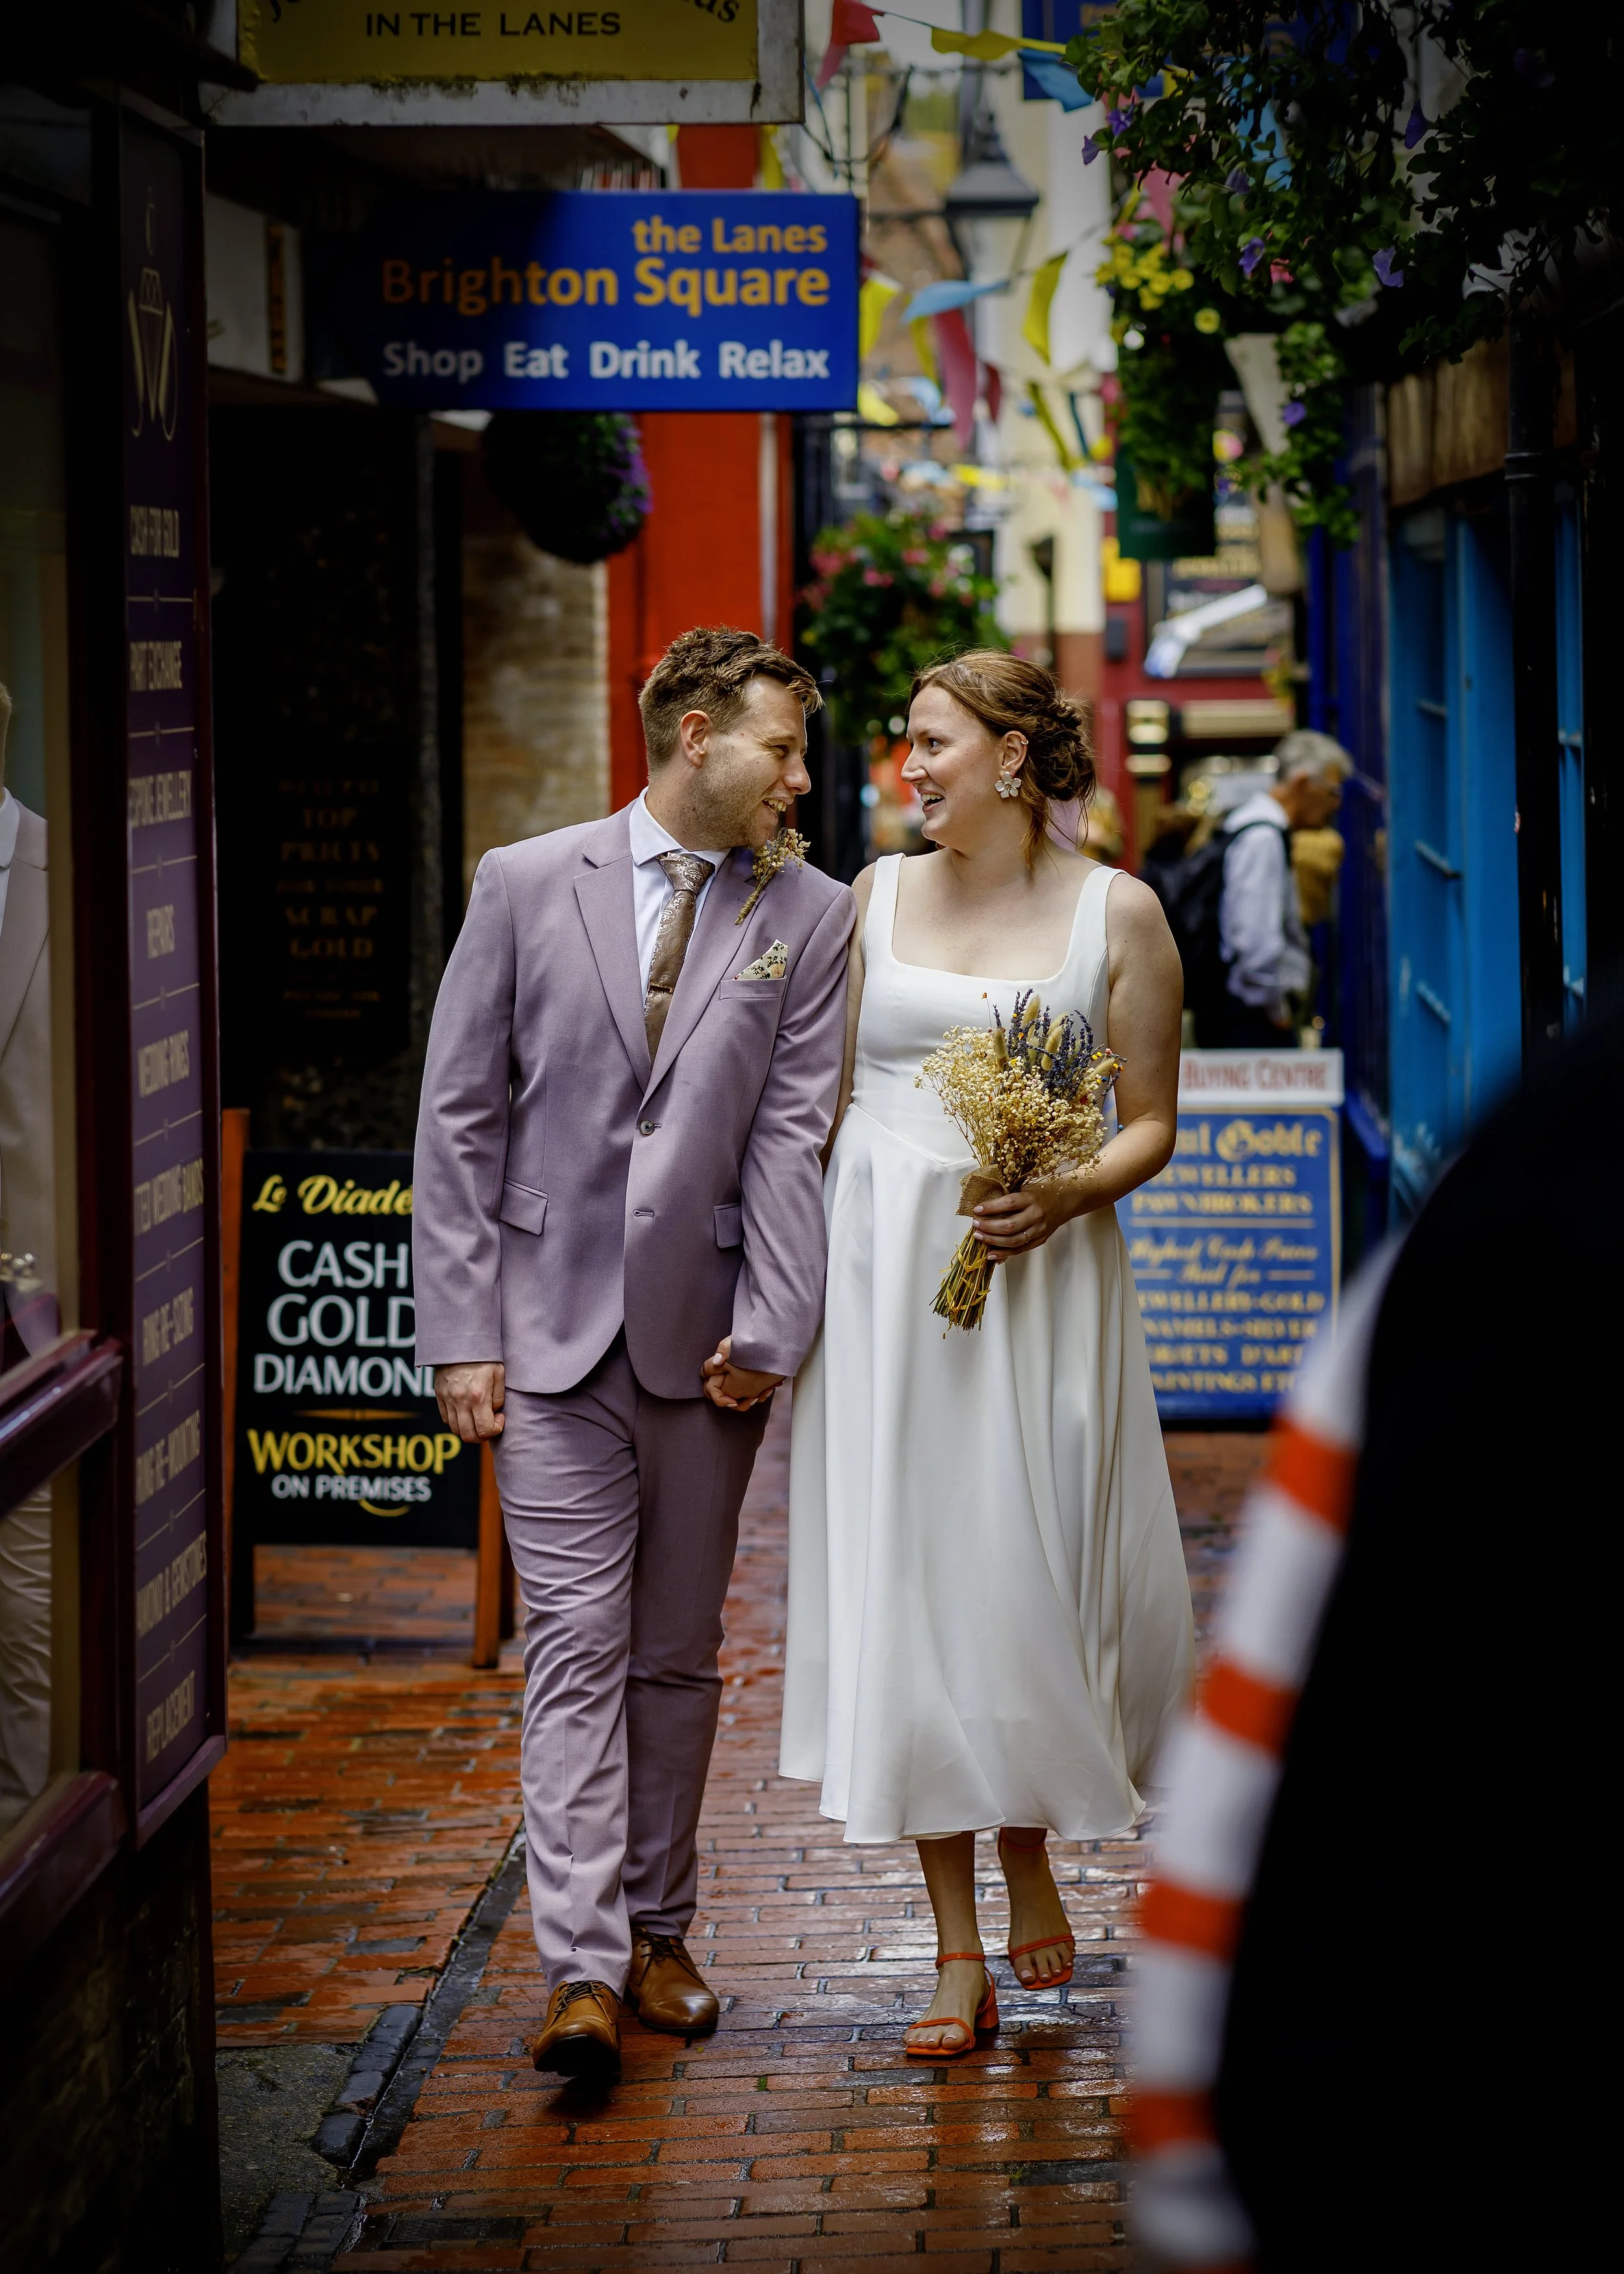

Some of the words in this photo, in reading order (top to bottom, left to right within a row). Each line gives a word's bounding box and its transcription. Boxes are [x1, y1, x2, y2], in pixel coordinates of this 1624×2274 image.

[366, 13, 400, 36] IN
[411, 13, 481, 36] THE
[500, 13, 621, 36] LANES
[633, 216, 702, 253] the
[712, 217, 828, 253] Lanes
[382, 256, 618, 316] Brighton
[634, 257, 831, 317] Square
[383, 342, 483, 383] Shop
[504, 341, 570, 379] Eat
[589, 340, 702, 379] Drink
[718, 340, 831, 379] Relax
[252, 1174, 288, 1213] Le
[277, 1239, 409, 1289] CASH
[266, 1293, 416, 1348] GOLD
[247, 1429, 462, 1475] WORKSHOP
[271, 1474, 311, 1500] ON
[314, 1474, 433, 1502] PREMISES
